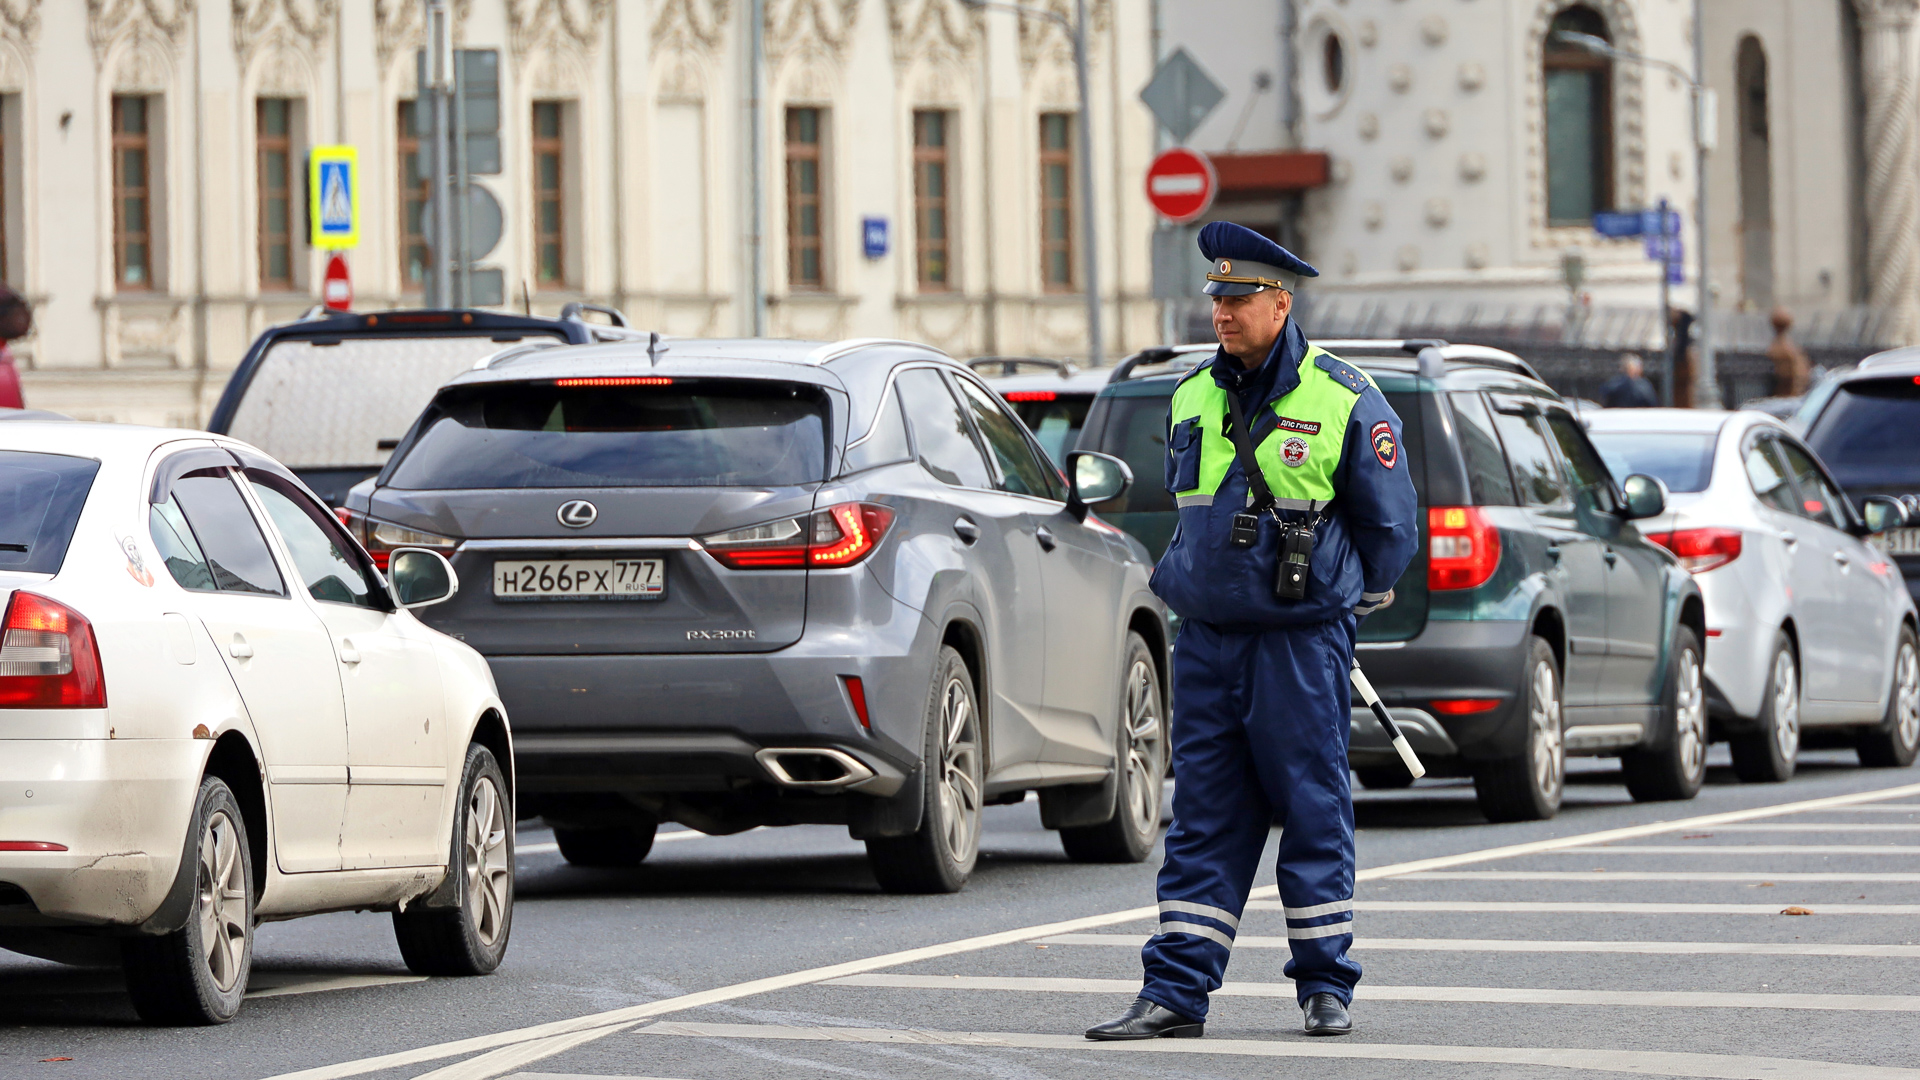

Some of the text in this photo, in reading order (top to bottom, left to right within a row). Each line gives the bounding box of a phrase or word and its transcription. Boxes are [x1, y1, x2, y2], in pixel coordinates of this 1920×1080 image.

[1280, 419, 1318, 432] ДПС ГИБДД
[503, 561, 656, 592] Н266РХ 777
[625, 583, 646, 591] RUS
